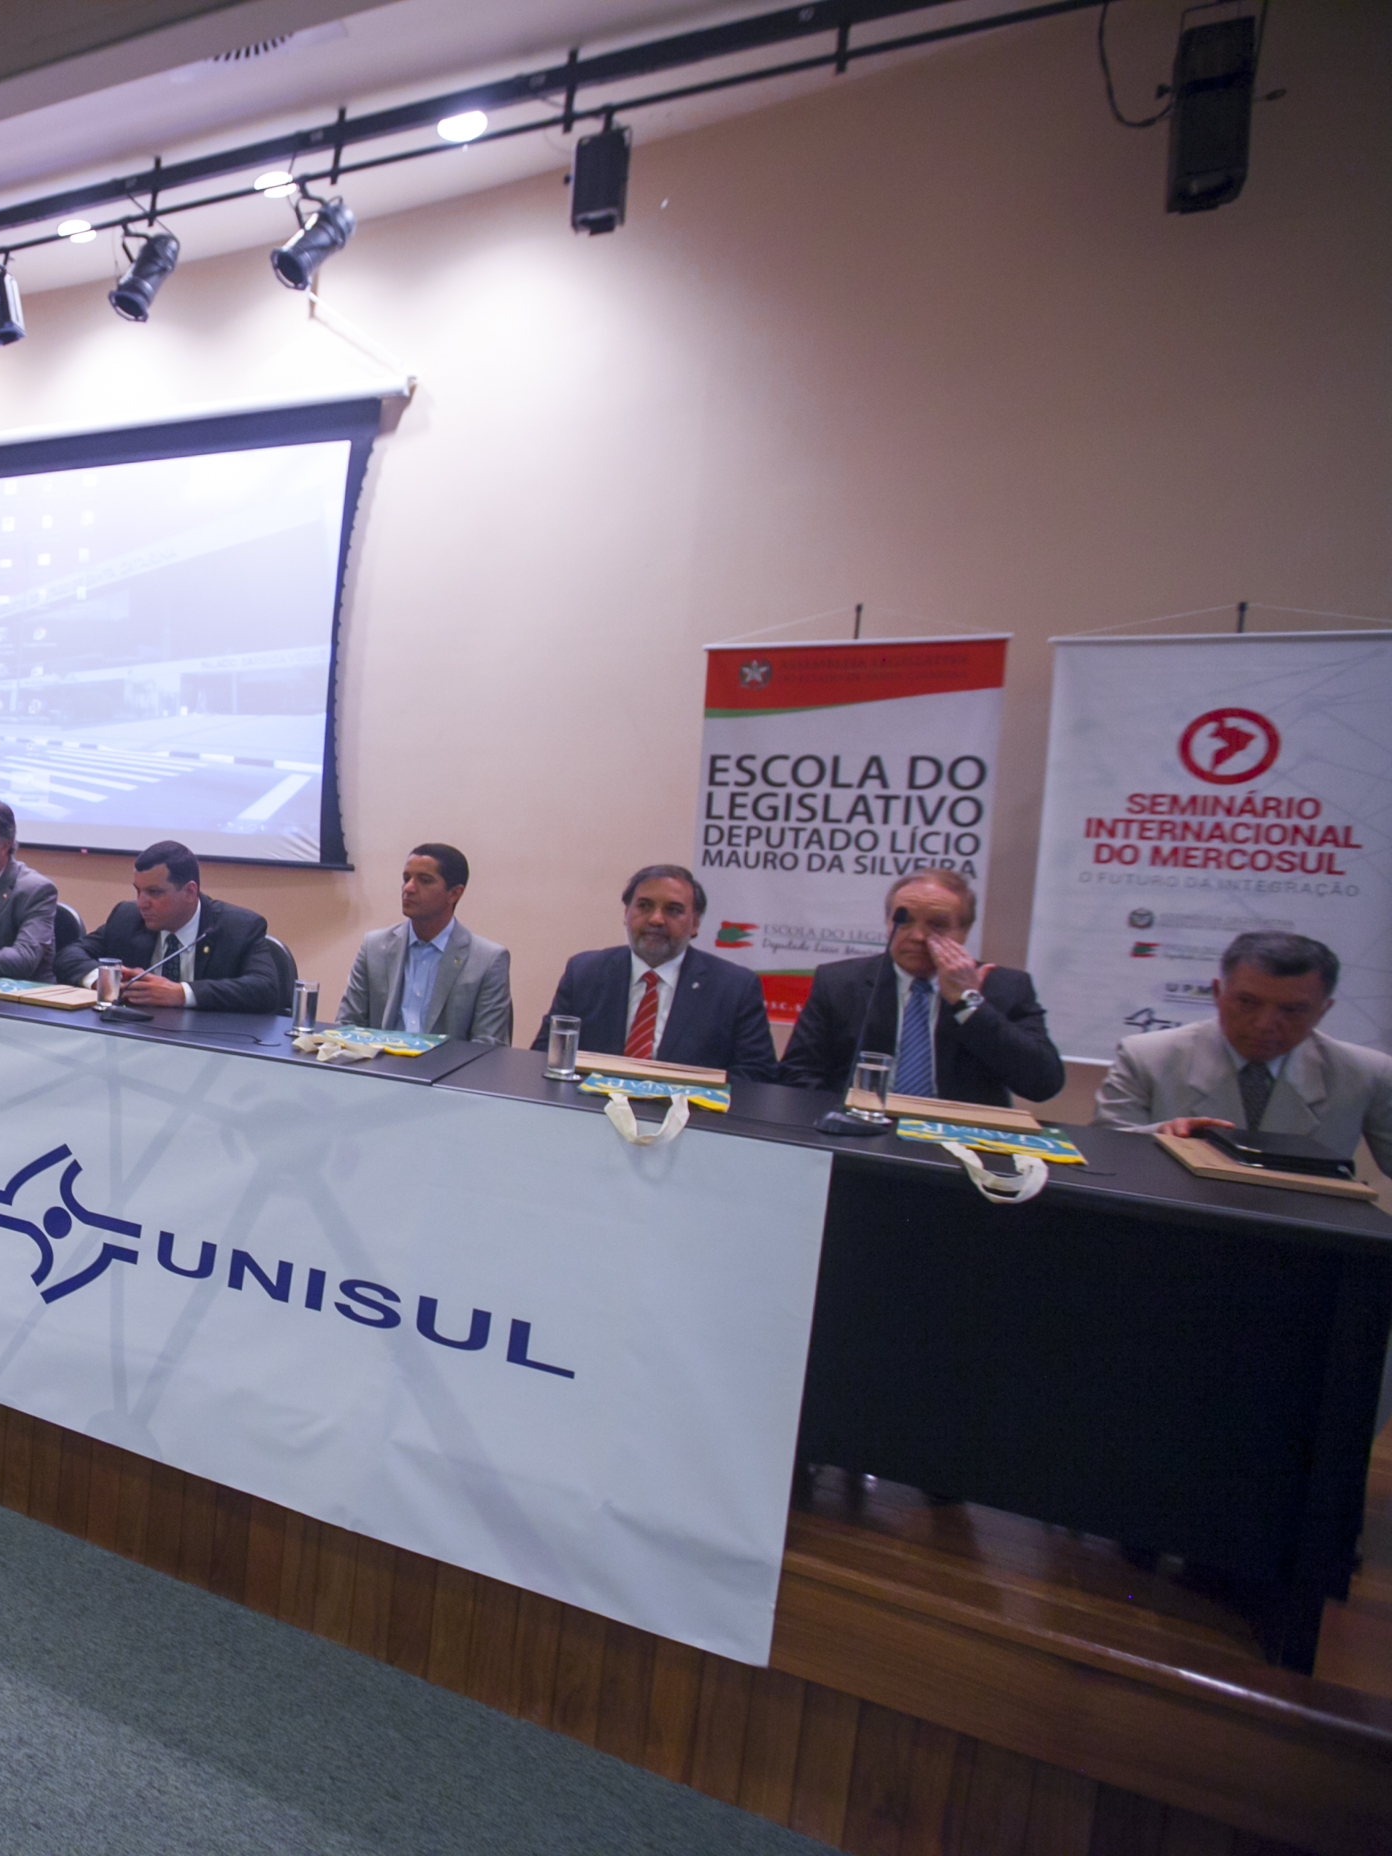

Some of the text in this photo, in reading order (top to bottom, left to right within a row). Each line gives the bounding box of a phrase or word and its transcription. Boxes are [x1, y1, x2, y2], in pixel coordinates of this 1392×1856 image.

[708, 754, 987, 791] ESCOLA DO
[704, 791, 985, 828] LEGISLATIVO
[1125, 790, 1322, 820] SEMINÁRIO
[703, 824, 981, 857] DEPUTADO LÍCIO
[1083, 817, 1364, 850] INTERNACIONAL
[701, 849, 800, 872] MAURO
[807, 853, 846, 875] DA
[1092, 843, 1346, 877] DO MERCOSUL
[1097, 872, 1180, 889] FUTURO
[1184, 876, 1210, 891] DA
[1217, 878, 1360, 898] INTEGRAÇÃO
[156, 1229, 576, 1379] UNISUL
